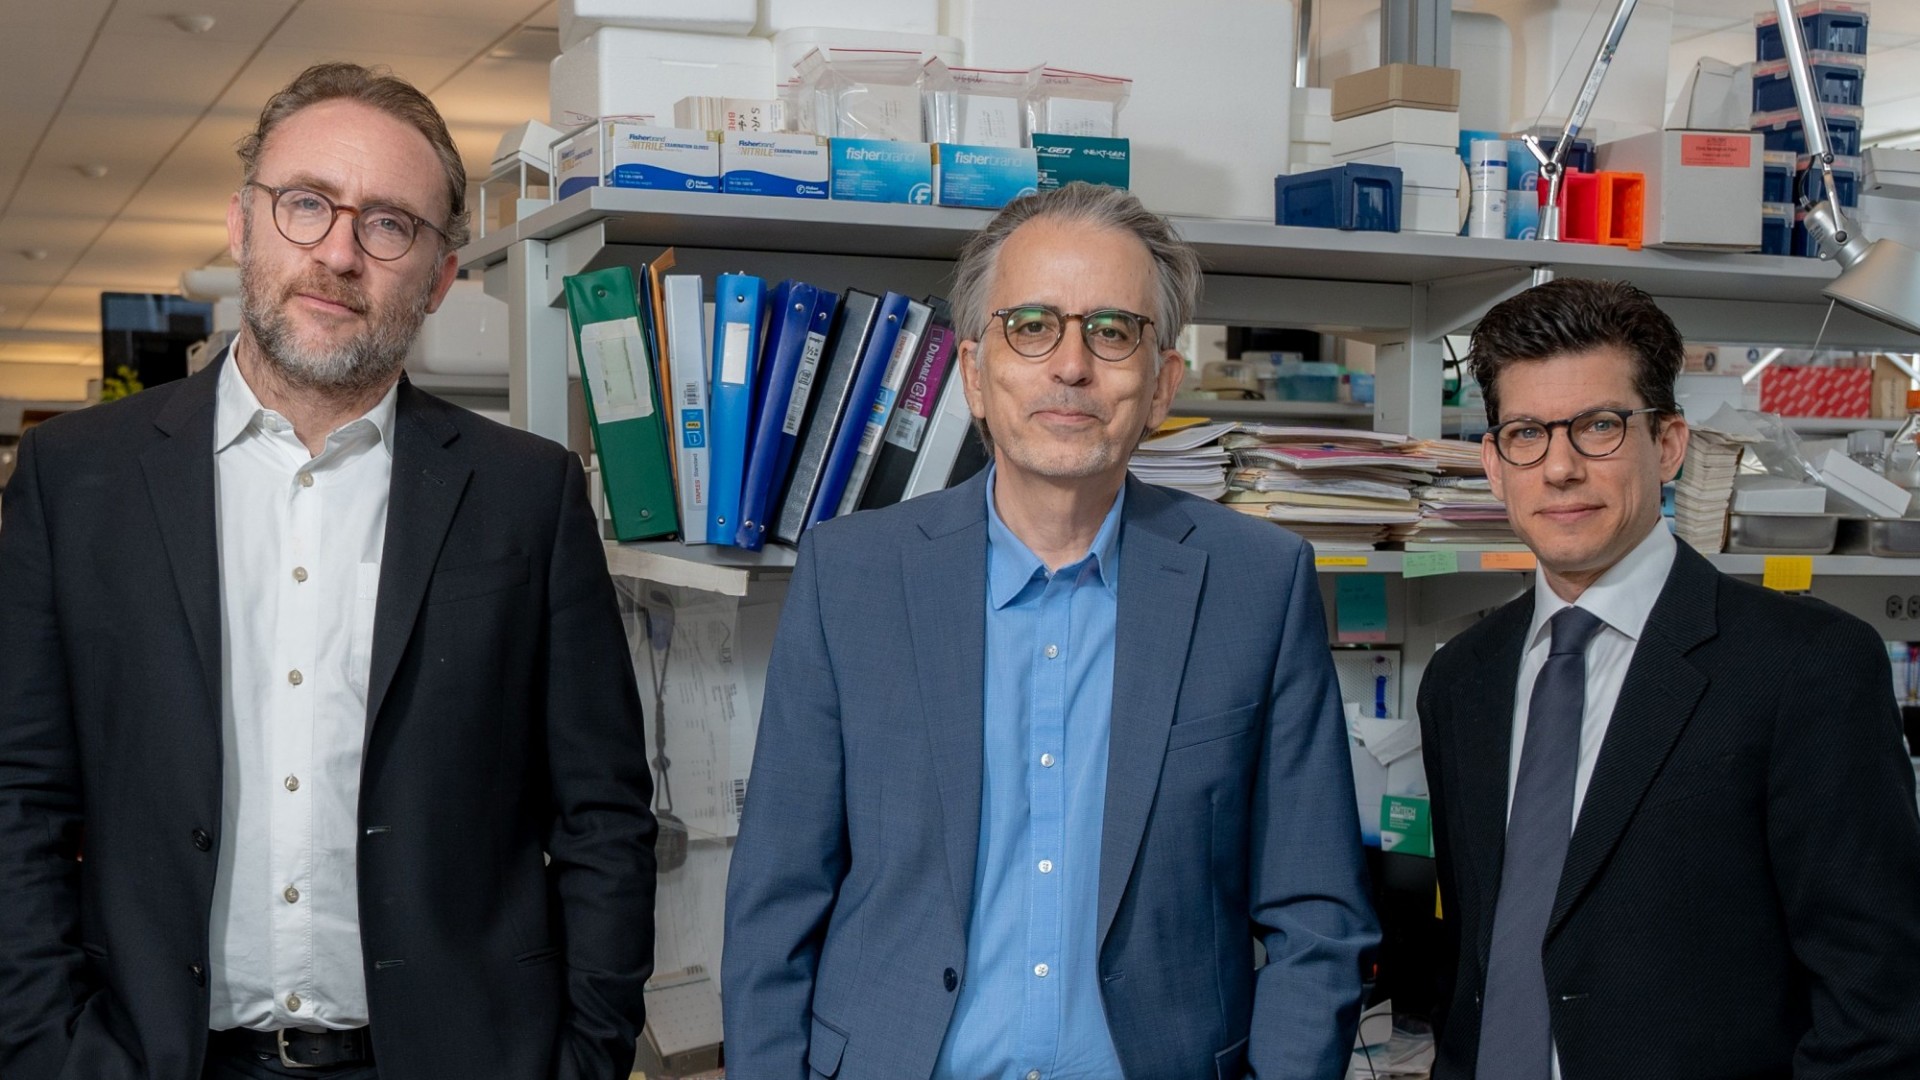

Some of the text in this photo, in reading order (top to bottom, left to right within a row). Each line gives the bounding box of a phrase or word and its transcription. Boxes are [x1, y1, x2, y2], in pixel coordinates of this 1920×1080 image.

[629, 133, 665, 142] Fisherbrand
[631, 141, 664, 151] NITRILE
[739, 140, 775, 148] Fisherbrand
[741, 147, 774, 157] NITRILE
[846, 147, 915, 163] fisherbrand
[955, 151, 1022, 167] fisherbrand
[919, 342, 940, 382] DURABLE
